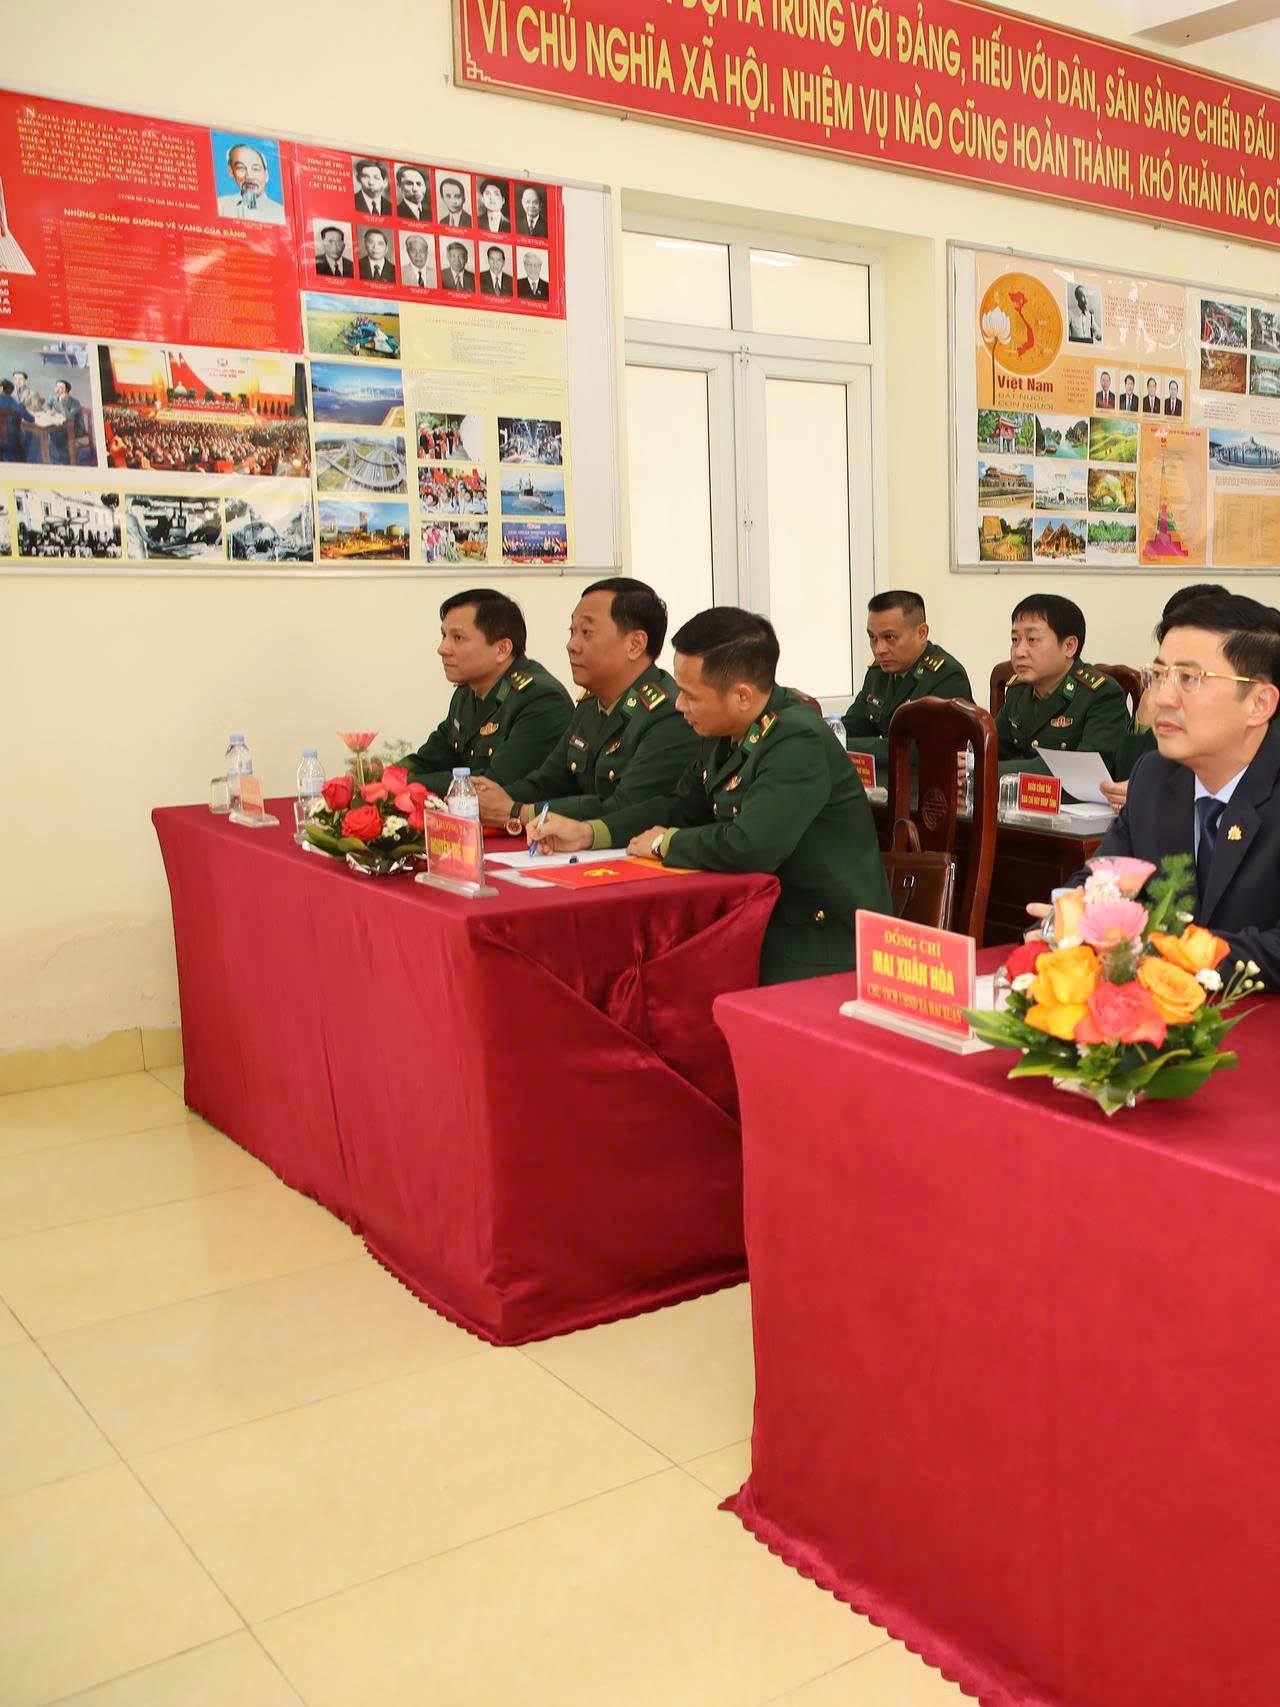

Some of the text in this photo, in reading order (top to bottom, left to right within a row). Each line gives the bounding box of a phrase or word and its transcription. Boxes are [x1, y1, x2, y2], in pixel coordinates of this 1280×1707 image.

[516, 0, 577, 72] CHỦ
[586, 21, 676, 94] NGHĨA
[681, 35, 719, 102] XÃ
[725, 46, 775, 123] HỘI.
[782, 64, 853, 138] NHIỆM
[859, 85, 888, 149] VỤ
[896, 82, 943, 150] NÀO
[949, 98, 1008, 164] CŨNG
[1013, 115, 1067, 178] HOÀN
[1073, 128, 1134, 200] THÀNH,
[1139, 147, 1174, 201] KHÓ
[1179, 158, 1221, 213] KHĂN
[1226, 165, 1260, 222] NÀO
[897, 7, 966, 86] ĐẢNG,
[972, 24, 1012, 90] HIẾU
[1018, 40, 1051, 100] VỚI
[1057, 54, 1101, 120] DÂN,
[1144, 73, 1190, 137] SÀNG
[1194, 93, 1240, 151] CHIẾN
[1244, 104, 1275, 160] ĐẤU
[1027, 378, 1054, 392] Nam
[872, 949, 894, 977] MAI
[896, 955, 928, 988] XUÂN
